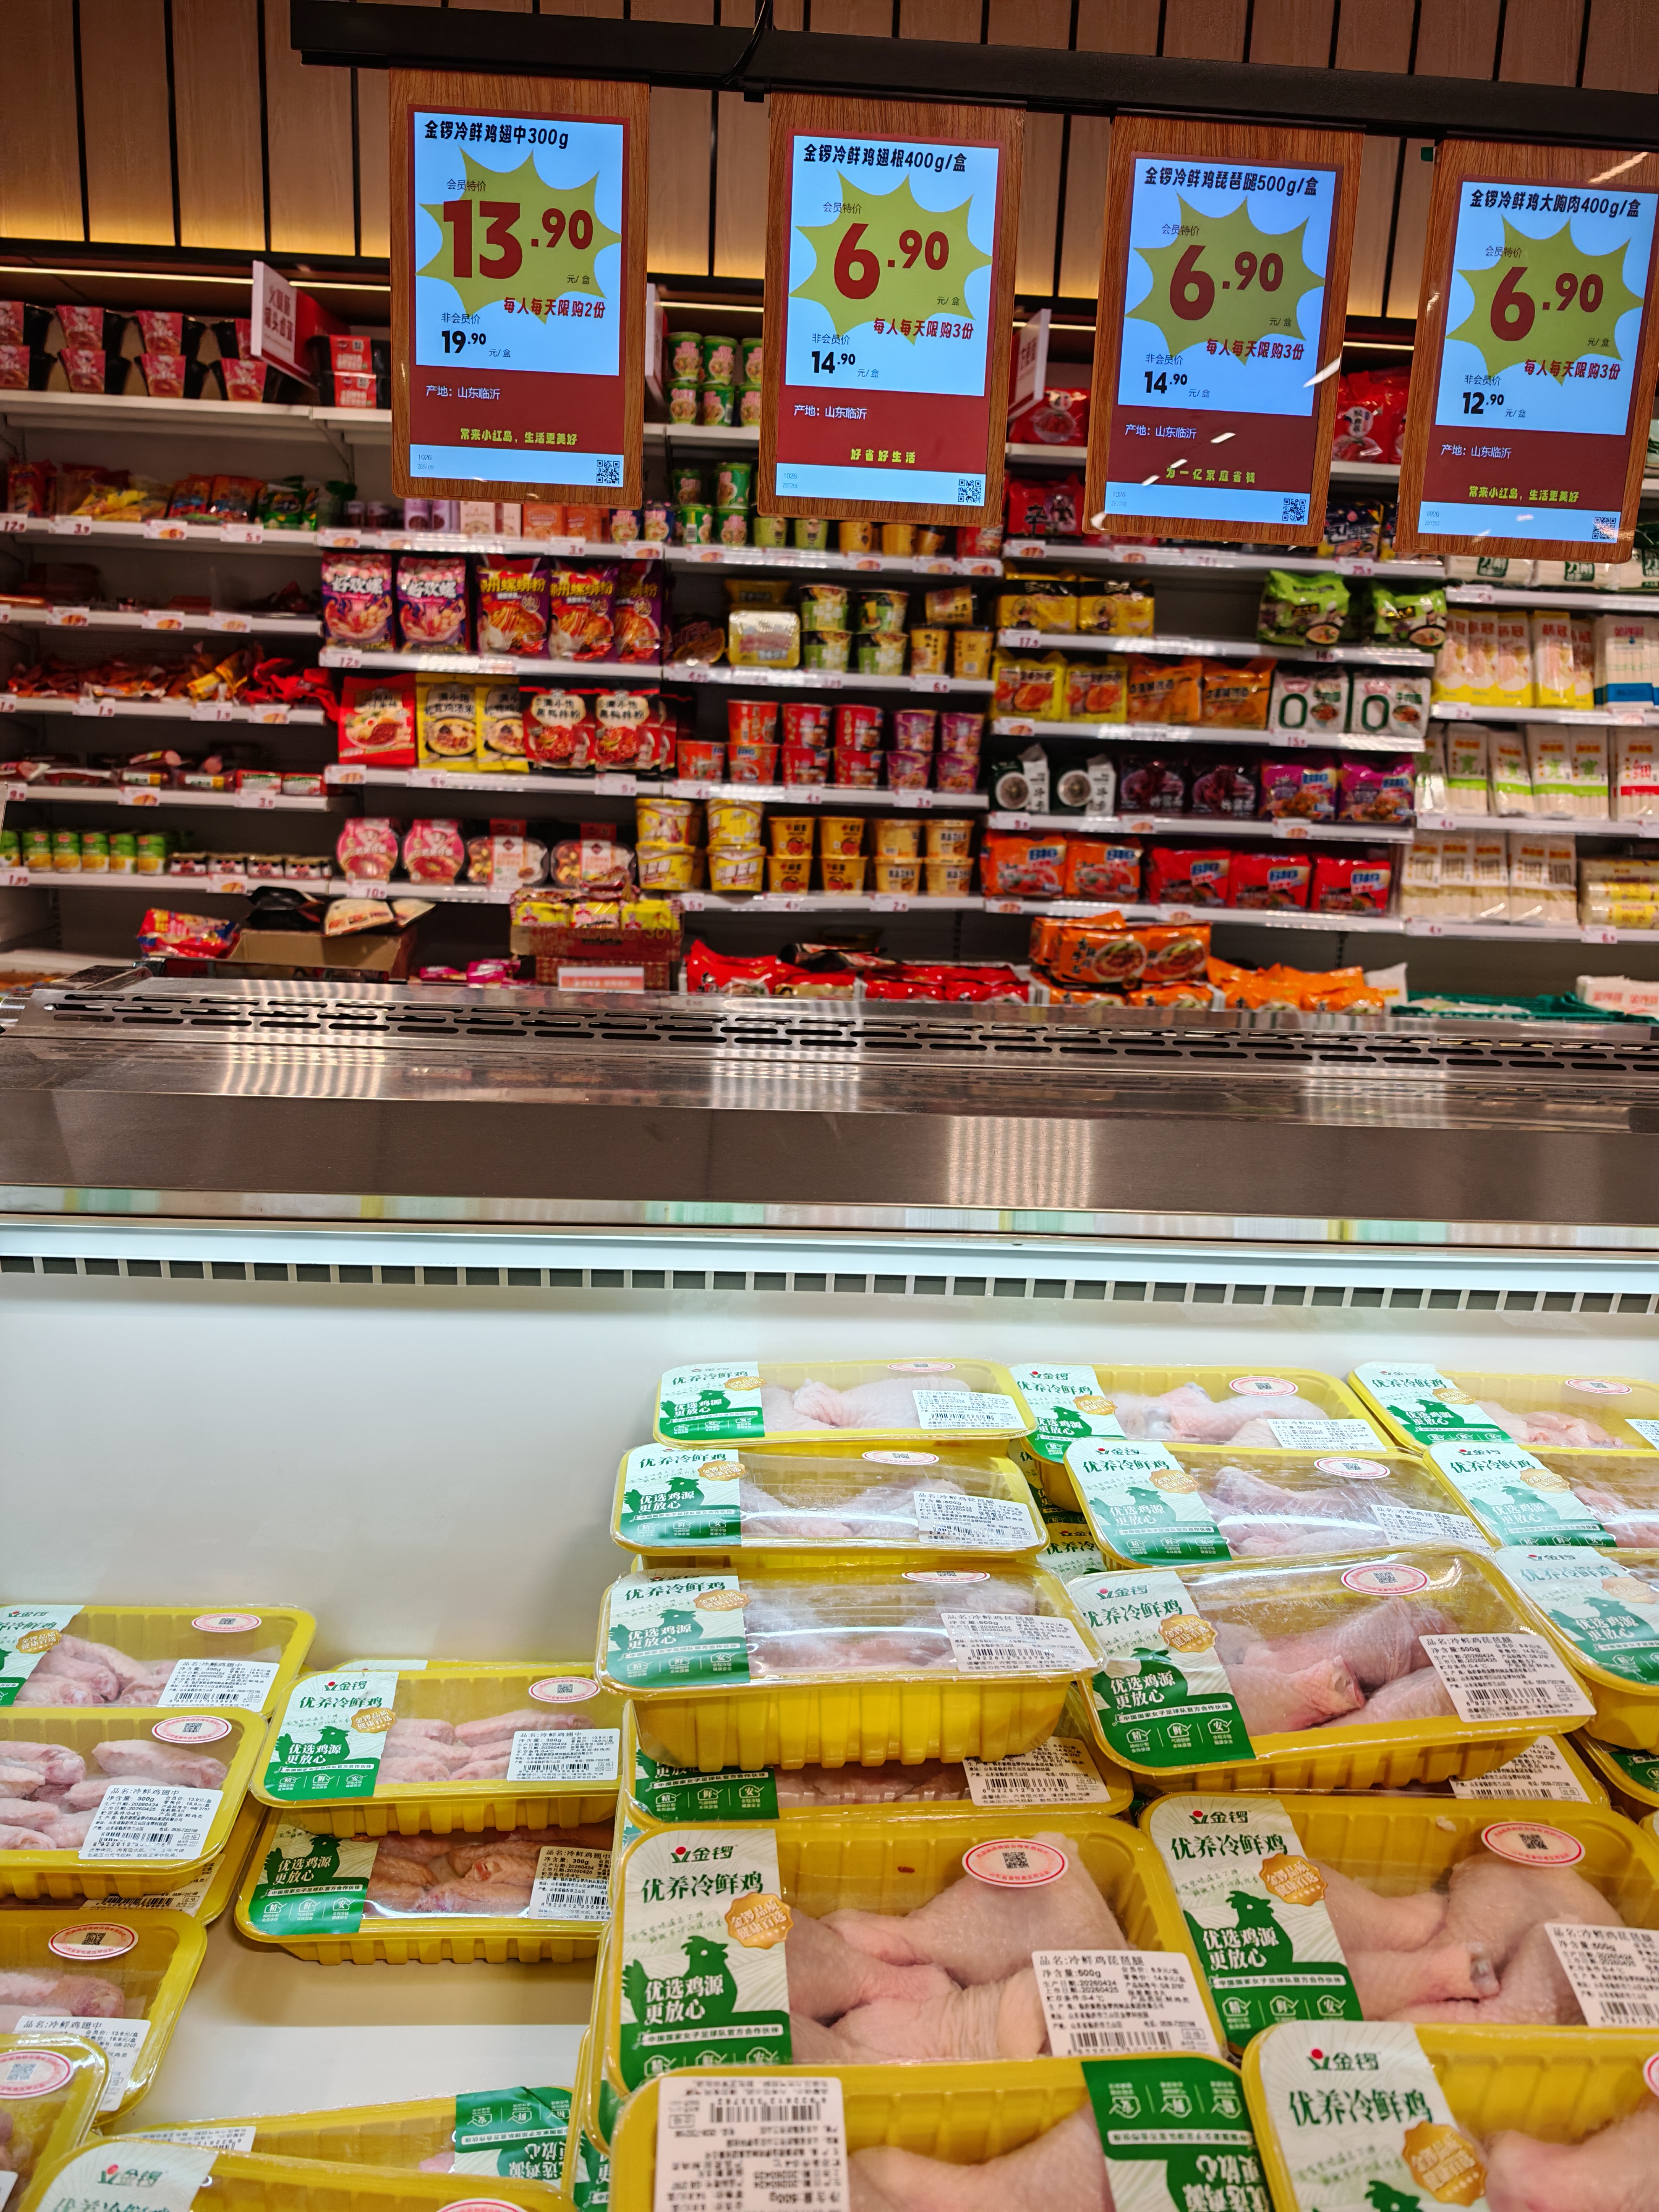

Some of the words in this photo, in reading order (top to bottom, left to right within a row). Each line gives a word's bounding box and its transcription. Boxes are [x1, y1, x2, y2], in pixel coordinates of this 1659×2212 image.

[425, 120, 568, 149] 金锣冷鲜鸡翅中300g
[804, 144, 967, 173] 金锣冷鲜鸡翅根400g/盒
[447, 179, 486, 192] 会员特价
[1144, 167, 1318, 195] 金锣冷鲜鸡琵琶腿500g/盒
[824, 201, 862, 214] 会员特价
[1470, 190, 1641, 218] 金锣冷鲜鸡大胸肉400g/盒
[1162, 224, 1200, 236] 会员特价
[443, 199, 593, 280] 13.90
[1485, 245, 1522, 258] 会员特价
[834, 223, 949, 300] 6.90
[1170, 245, 1284, 320] 6.90
[504, 297, 605, 319] 每人每天限购2份
[1490, 267, 1603, 342] 6.90
[441, 313, 480, 325] 非会员价
[874, 318, 974, 340] 每人每天限购3份
[441, 330, 486, 354] 19.90
[812, 333, 850, 345] 非会员价
[1206, 339, 1304, 361] 每人每天限购3份
[812, 350, 855, 374] 14.90
[1146, 354, 1183, 366] 非会员价
[1525, 359, 1621, 380] 每人每天限购3份
[1144, 372, 1188, 394] 14.90
[1464, 375, 1501, 386] 非会员价
[1462, 392, 1504, 415] 12.90
[672, 1370, 749, 1386] 优养冷鲜鸡
[1372, 1378, 1447, 1389] 优养冷鲜鸡
[1017, 1381, 1092, 1395] 优养冷鲜鸡
[674, 1398, 723, 1411] 优选鸡源
[674, 1405, 711, 1417] 更放心
[1037, 1417, 1083, 1430] 优选鸡源
[1406, 1411, 1454, 1420] 优选鸡源
[1413, 1417, 1449, 1426] 更放心
[1037, 1425, 1074, 1435] 更放心
[639, 1453, 727, 1470] 优养冷鲜鸡
[1083, 1458, 1170, 1475] 优养冷鲜鸡
[1451, 1460, 1535, 1473] 优养冷鲜鸡
[639, 1489, 695, 1505] 优选鸡源
[638, 1500, 680, 1513] 更放心
[1109, 1503, 1164, 1518] 优选鸡源
[1492, 1502, 1547, 1517] 优选鸡源
[1116, 1513, 1157, 1526] 更放心
[1500, 1514, 1542, 1525] 更放心
[1520, 1566, 1618, 1582] 优养冷鲜鸡
[625, 1581, 726, 1601] 优养冷鲜鸡
[1115, 1584, 1149, 1596] 金锣
[1083, 1599, 1183, 1628] 优养冷鲜鸡
[1575, 1616, 1639, 1631] 优选鸡源
[628, 1623, 691, 1641] 优选鸡源
[1588, 1628, 1635, 1641] 更放心
[628, 1635, 677, 1651] 更放心
[339, 1681, 368, 1691] 金锣
[1110, 1670, 1176, 1695] 优选鸡源
[299, 1696, 383, 1709] 优养冷鲜鸡
[1114, 1689, 1165, 1709] 更放心
[355, 1709, 389, 1724] 金锣品质
[1123, 1703, 1229, 1721] 中国国家女子足球队官方合作伙伴
[357, 1716, 393, 1729] 健康首选
[1212, 1722, 1223, 1731] 安
[288, 1744, 342, 1755] 优选鸡源
[287, 1754, 326, 1765] 更放心
[745, 1786, 754, 1797] 安
[1210, 1811, 1249, 1824] 金锣
[691, 1845, 734, 1863] 金锣
[1171, 1834, 1288, 1860] 优养冷鲜鸡
[278, 1854, 331, 1872] 优选鸡源
[273, 1870, 315, 1885] 更放心
[272, 1885, 361, 1896] 中国国家女子足球队官方合作伙伴
[640, 1871, 764, 1904] 优养冷鲜鸡
[303, 1901, 312, 1911] 鲜
[338, 1899, 347, 1908] 安
[731, 1899, 781, 1929] 金锣品质
[736, 1912, 787, 1940] 健康首选
[1203, 1926, 1279, 1950] 优选鸡源
[1207, 1947, 1266, 1971] 更放心
[645, 1973, 724, 2004] 优选鸡源
[644, 1998, 706, 2026] 更放心
[1333, 2052, 1380, 2071] 金锣
[1289, 2088, 1433, 2127] 优养冷鲜鸡
